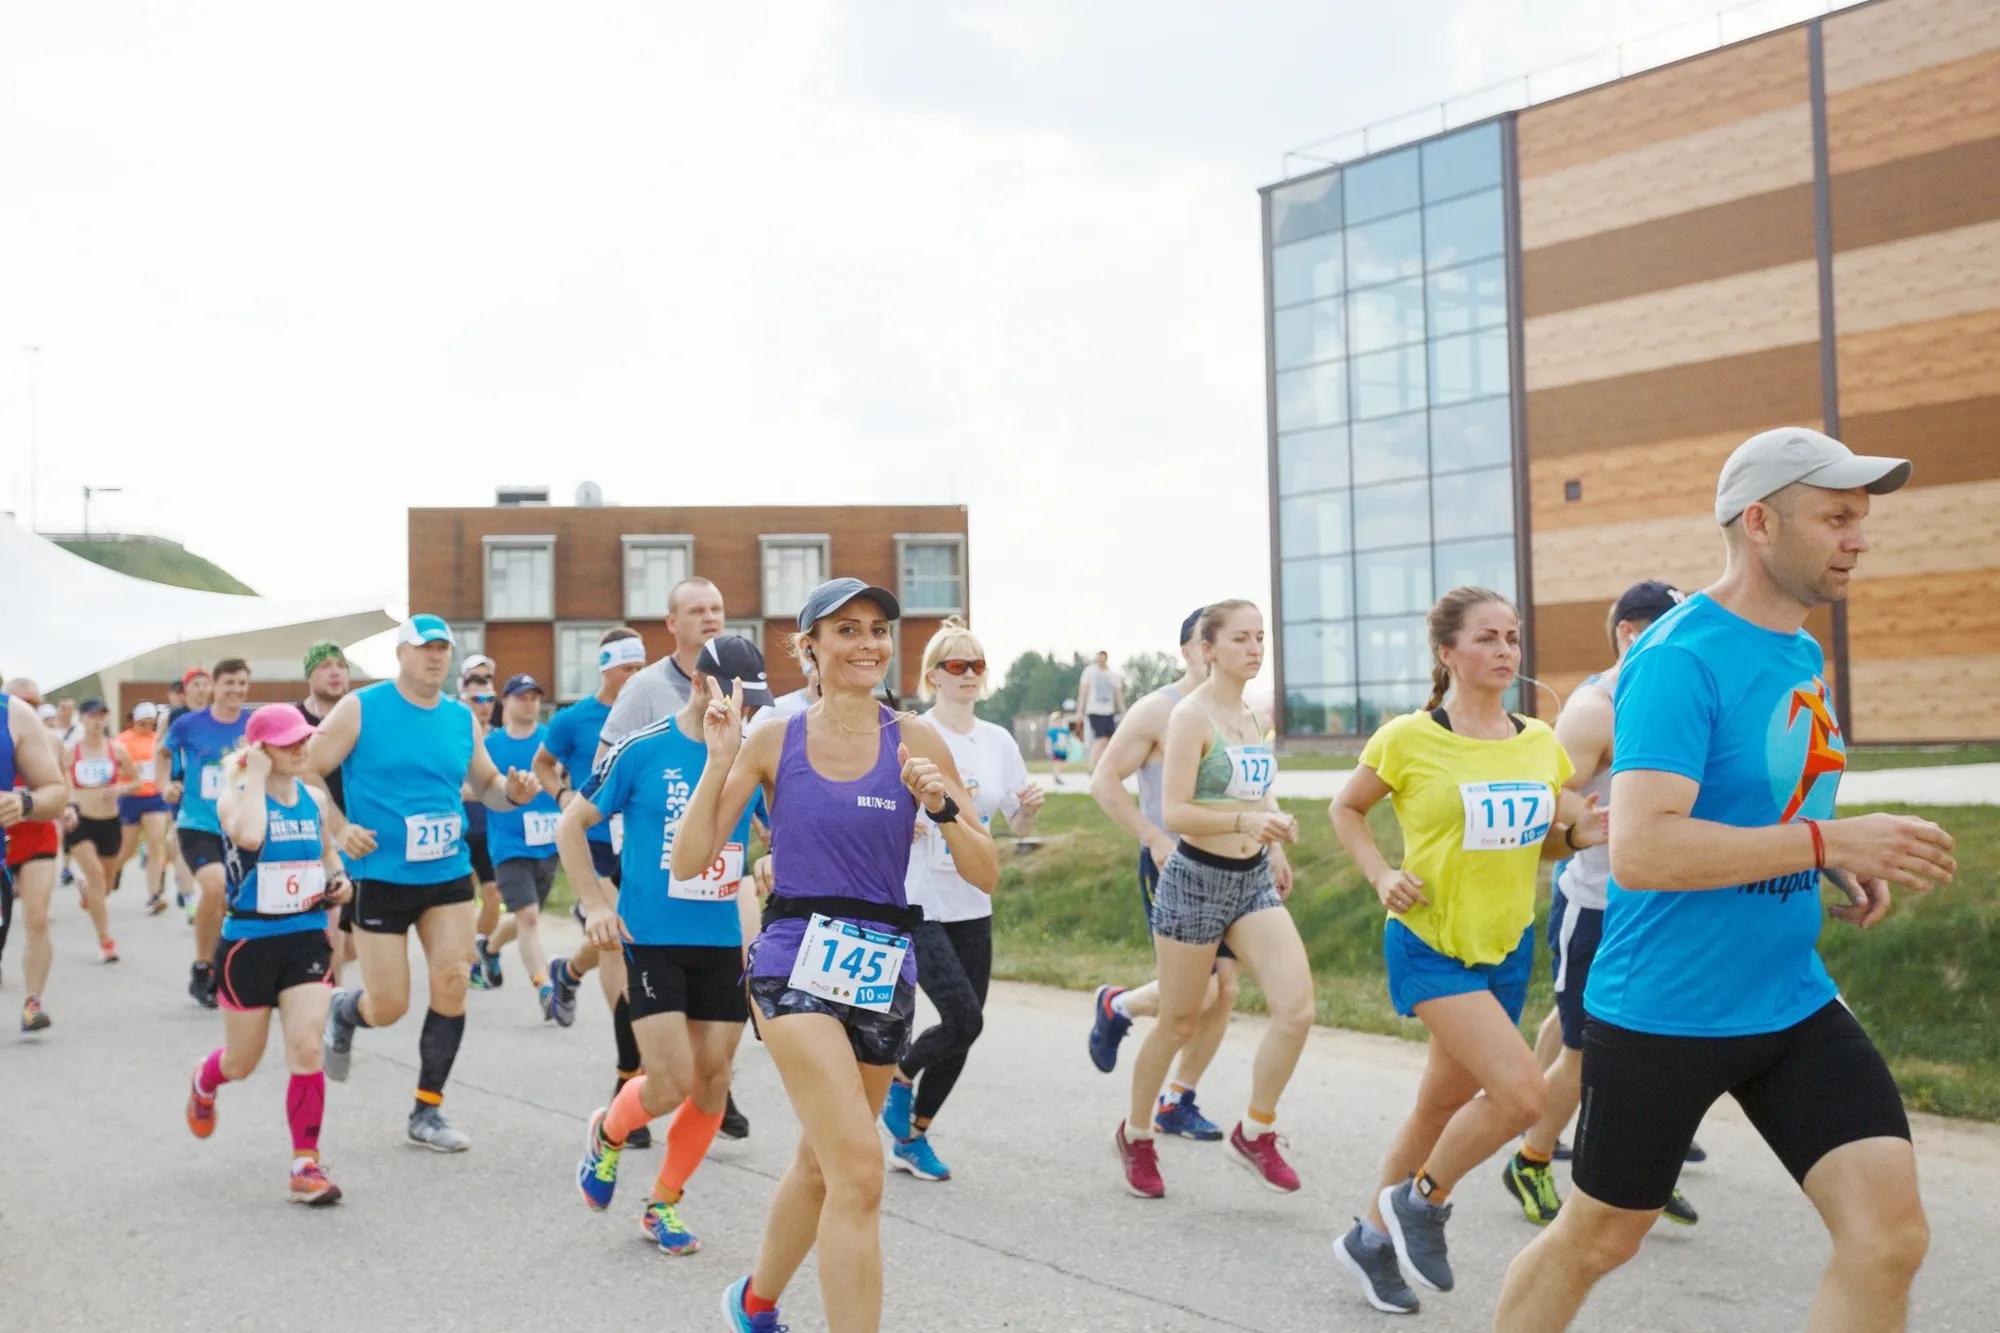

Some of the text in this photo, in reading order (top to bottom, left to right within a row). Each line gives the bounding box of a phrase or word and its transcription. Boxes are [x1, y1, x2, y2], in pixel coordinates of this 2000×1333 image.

[1241, 759, 1269, 782] 127
[857, 796, 896, 811] RUN-35
[1481, 797, 1539, 828] 117
[417, 823, 453, 845] 215
[286, 875, 299, 895] 6
[822, 939, 887, 983] 145
[860, 988, 875, 1001] 10
